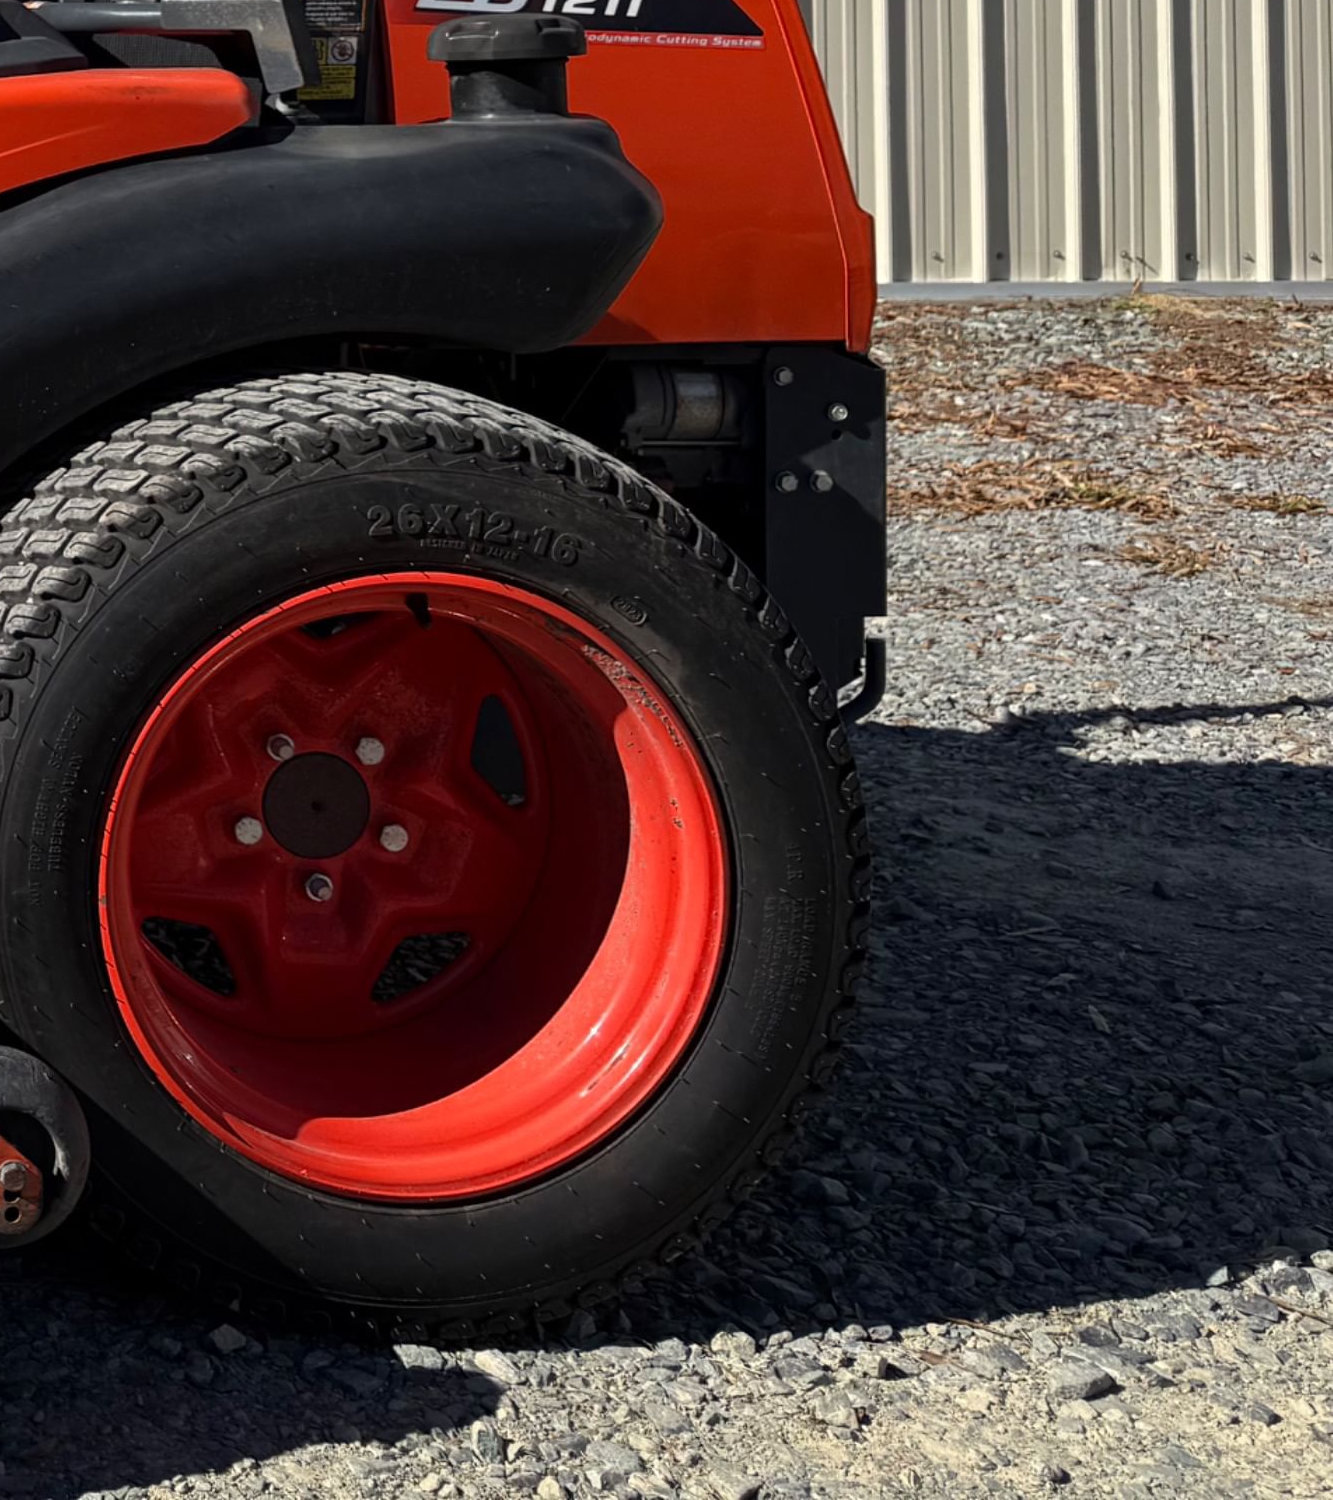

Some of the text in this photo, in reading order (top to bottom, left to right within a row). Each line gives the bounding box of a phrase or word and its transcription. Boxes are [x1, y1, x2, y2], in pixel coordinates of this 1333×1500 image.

[585, 33, 761, 48] odynamic Cutting System
[367, 503, 583, 566] 26X12-16
